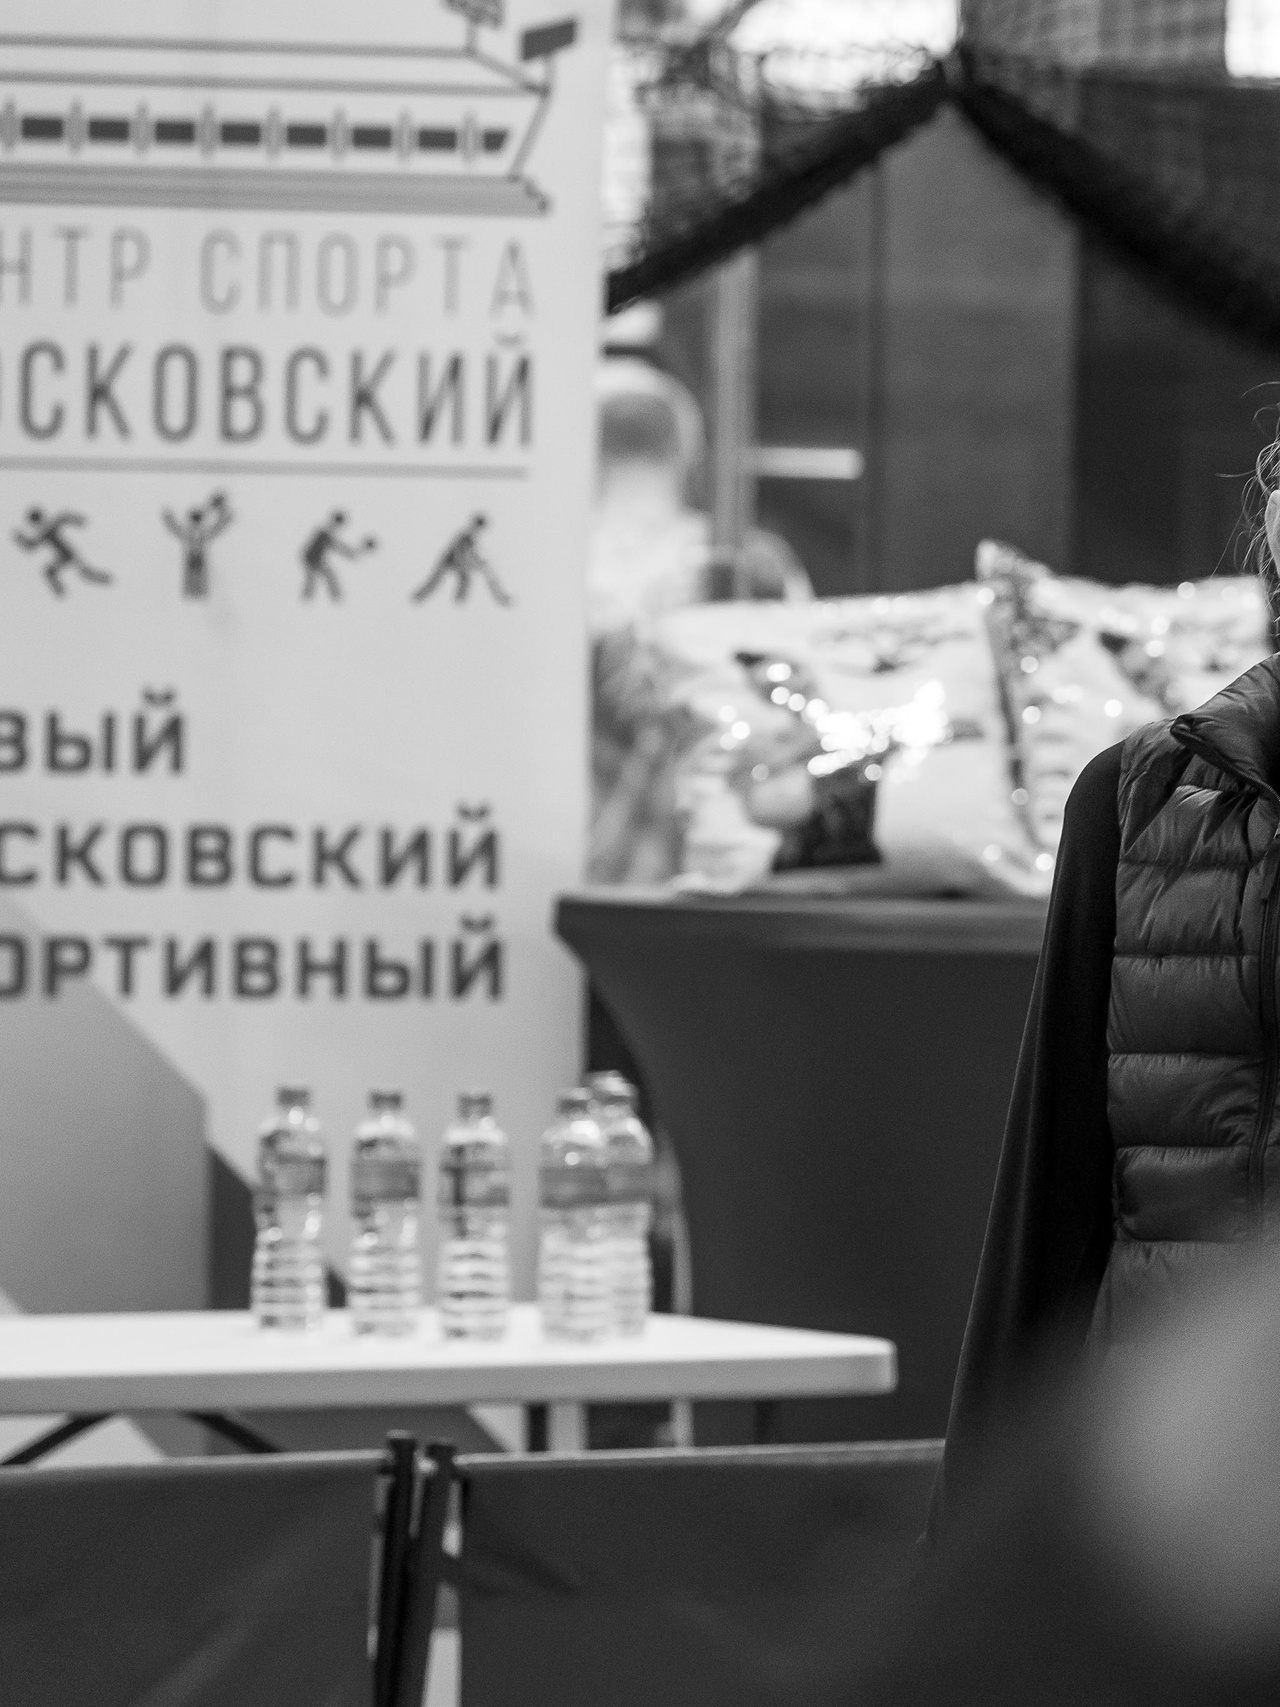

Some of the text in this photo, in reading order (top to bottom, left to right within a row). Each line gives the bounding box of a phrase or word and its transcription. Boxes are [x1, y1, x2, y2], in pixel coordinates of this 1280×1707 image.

[198, 229, 535, 318] СПОРТА
[0, 686, 185, 776] ВЫЙ
[0, 801, 500, 890] СКОВСКИЙ
